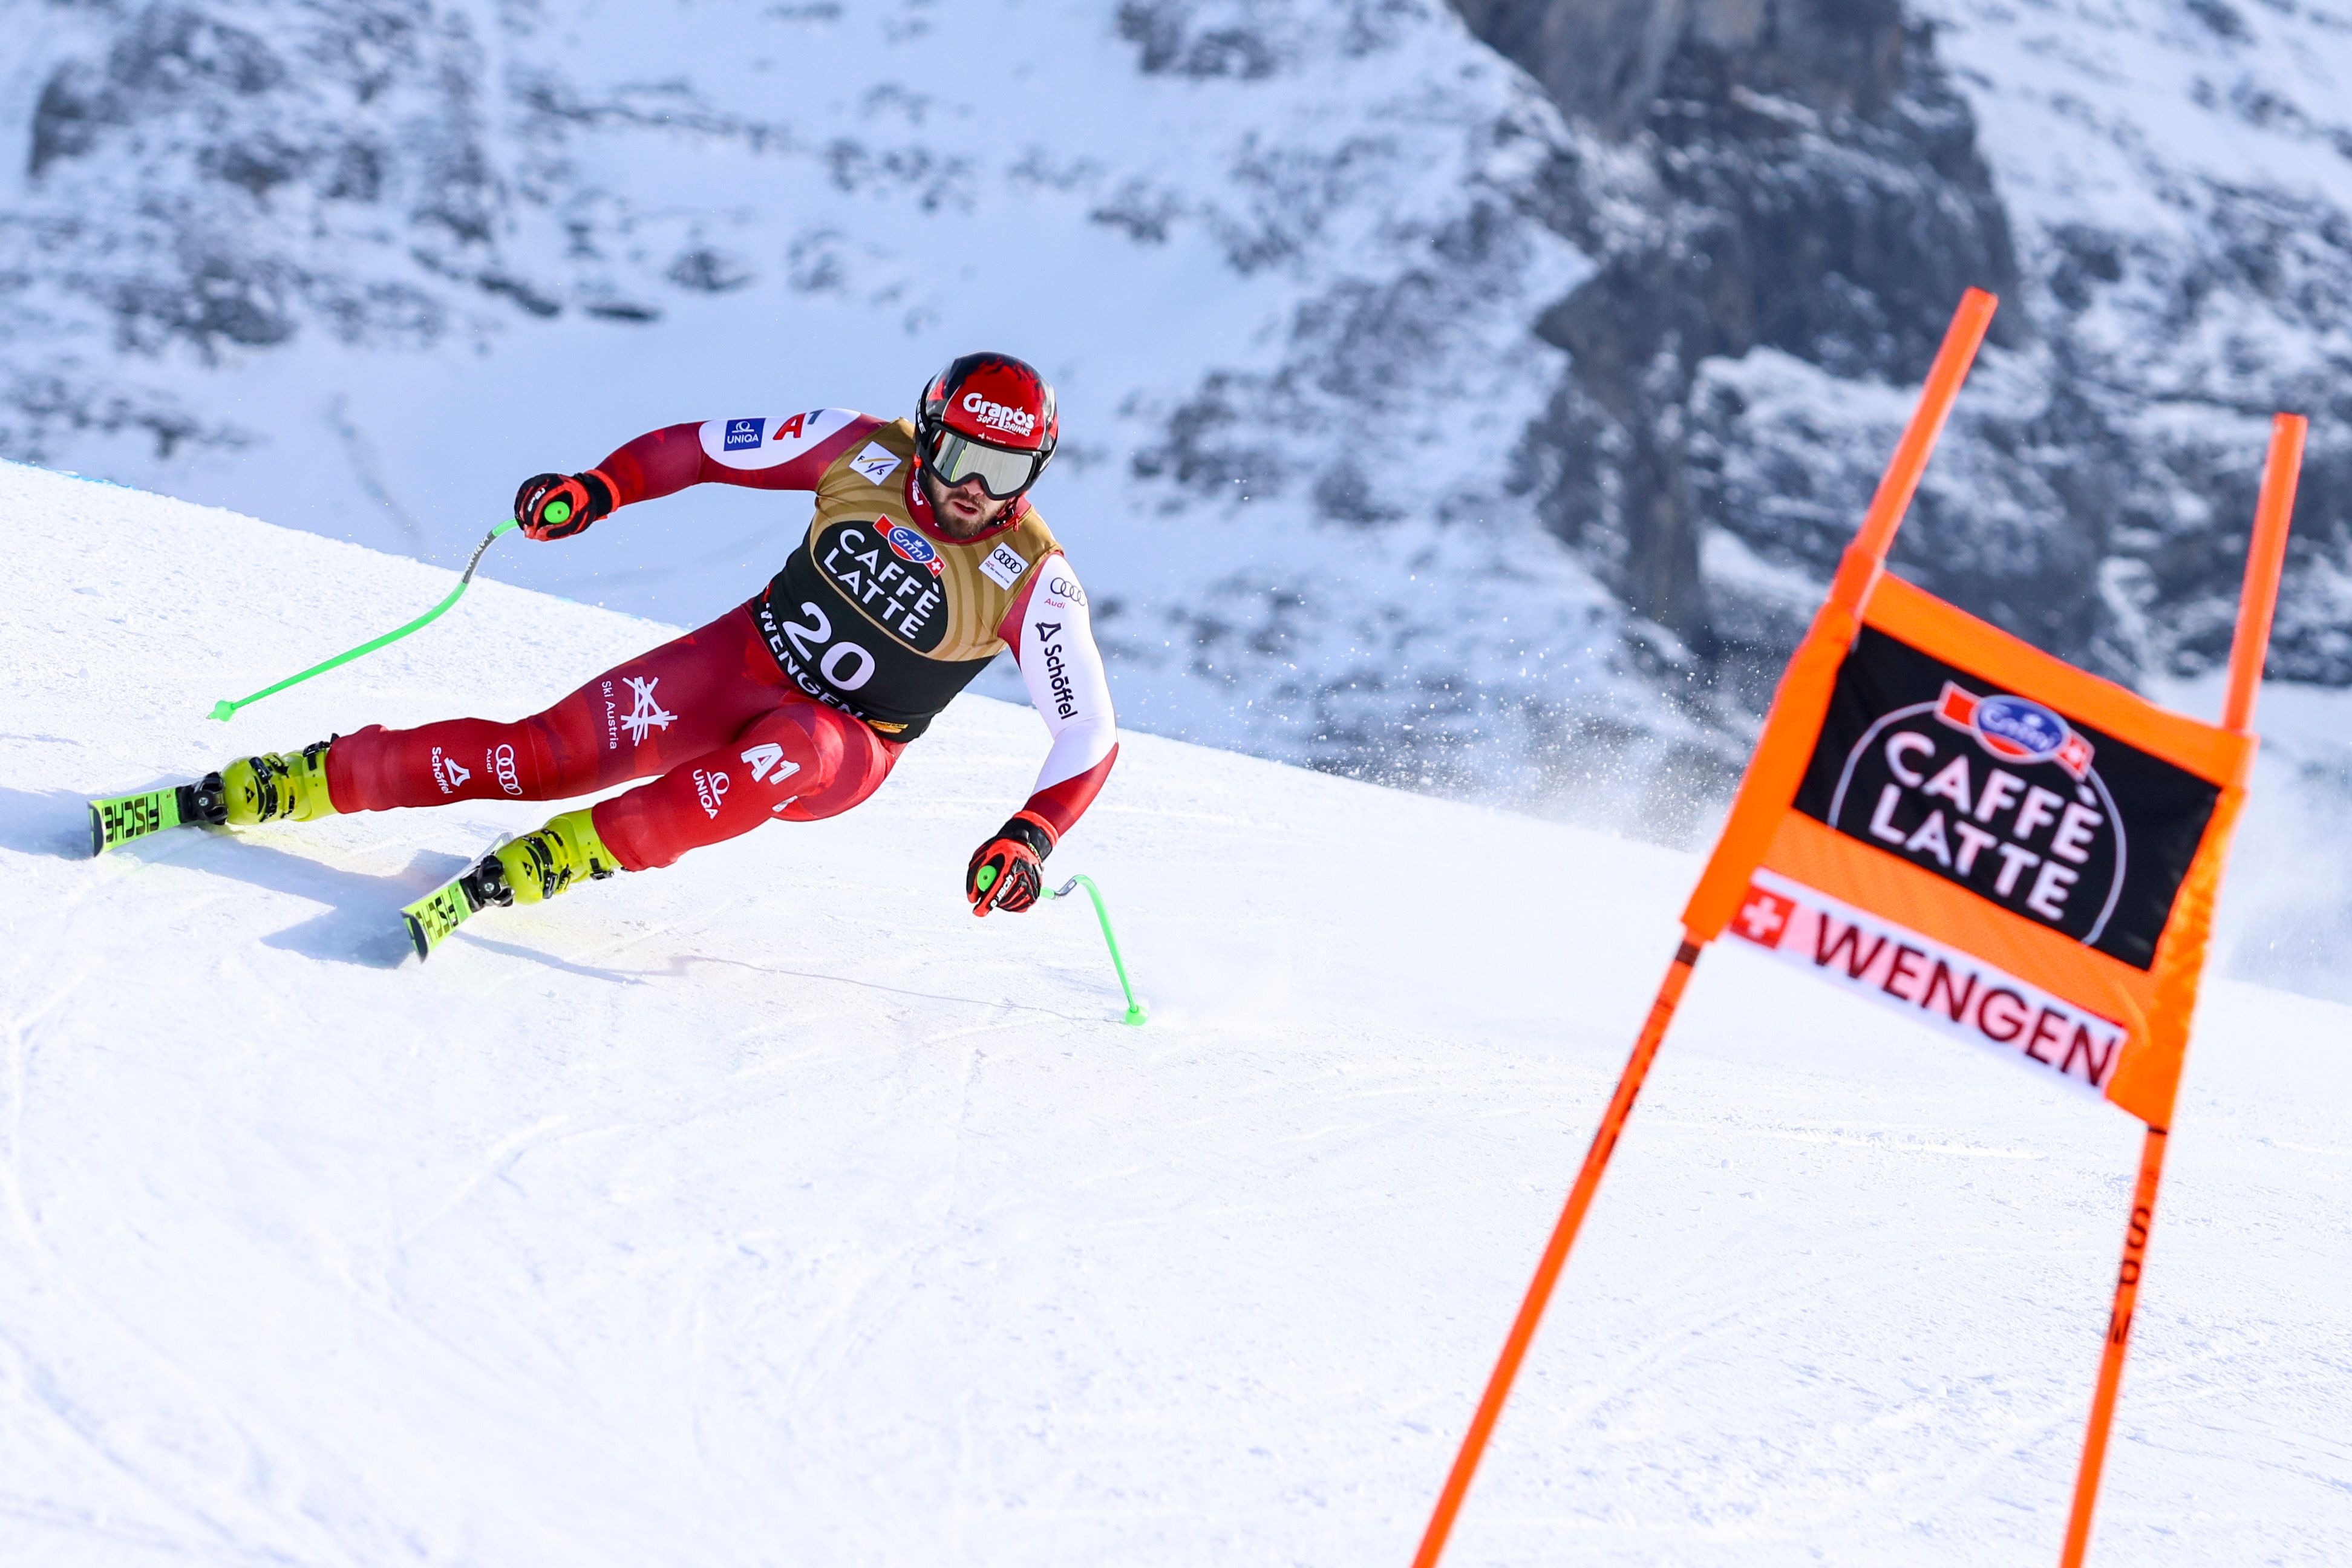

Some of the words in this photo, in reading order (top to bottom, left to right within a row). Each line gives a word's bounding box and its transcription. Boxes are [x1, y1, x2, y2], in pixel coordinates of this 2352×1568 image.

[727, 434, 759, 444] UNIQA
[773, 409, 826, 440] A1
[976, 414, 999, 425] SOFT
[1004, 422, 1031, 437] DRINKS
[893, 529, 930, 560] Emmi
[823, 547, 925, 639] LATTE
[840, 529, 941, 618] CAFFÈ
[1044, 598, 1066, 609] Audi
[760, 603, 864, 718] WENGEN
[782, 601, 875, 691] 20
[601, 681, 614, 698] Ski
[605, 701, 617, 750] Austria
[740, 742, 801, 785] A1
[102, 794, 160, 843] FISCHE
[693, 769, 719, 820] UNIQA
[1884, 731, 2103, 864] CAFFÈ
[1869, 783, 2080, 921] LATTE
[1813, 912, 2117, 1088] WENGEN
